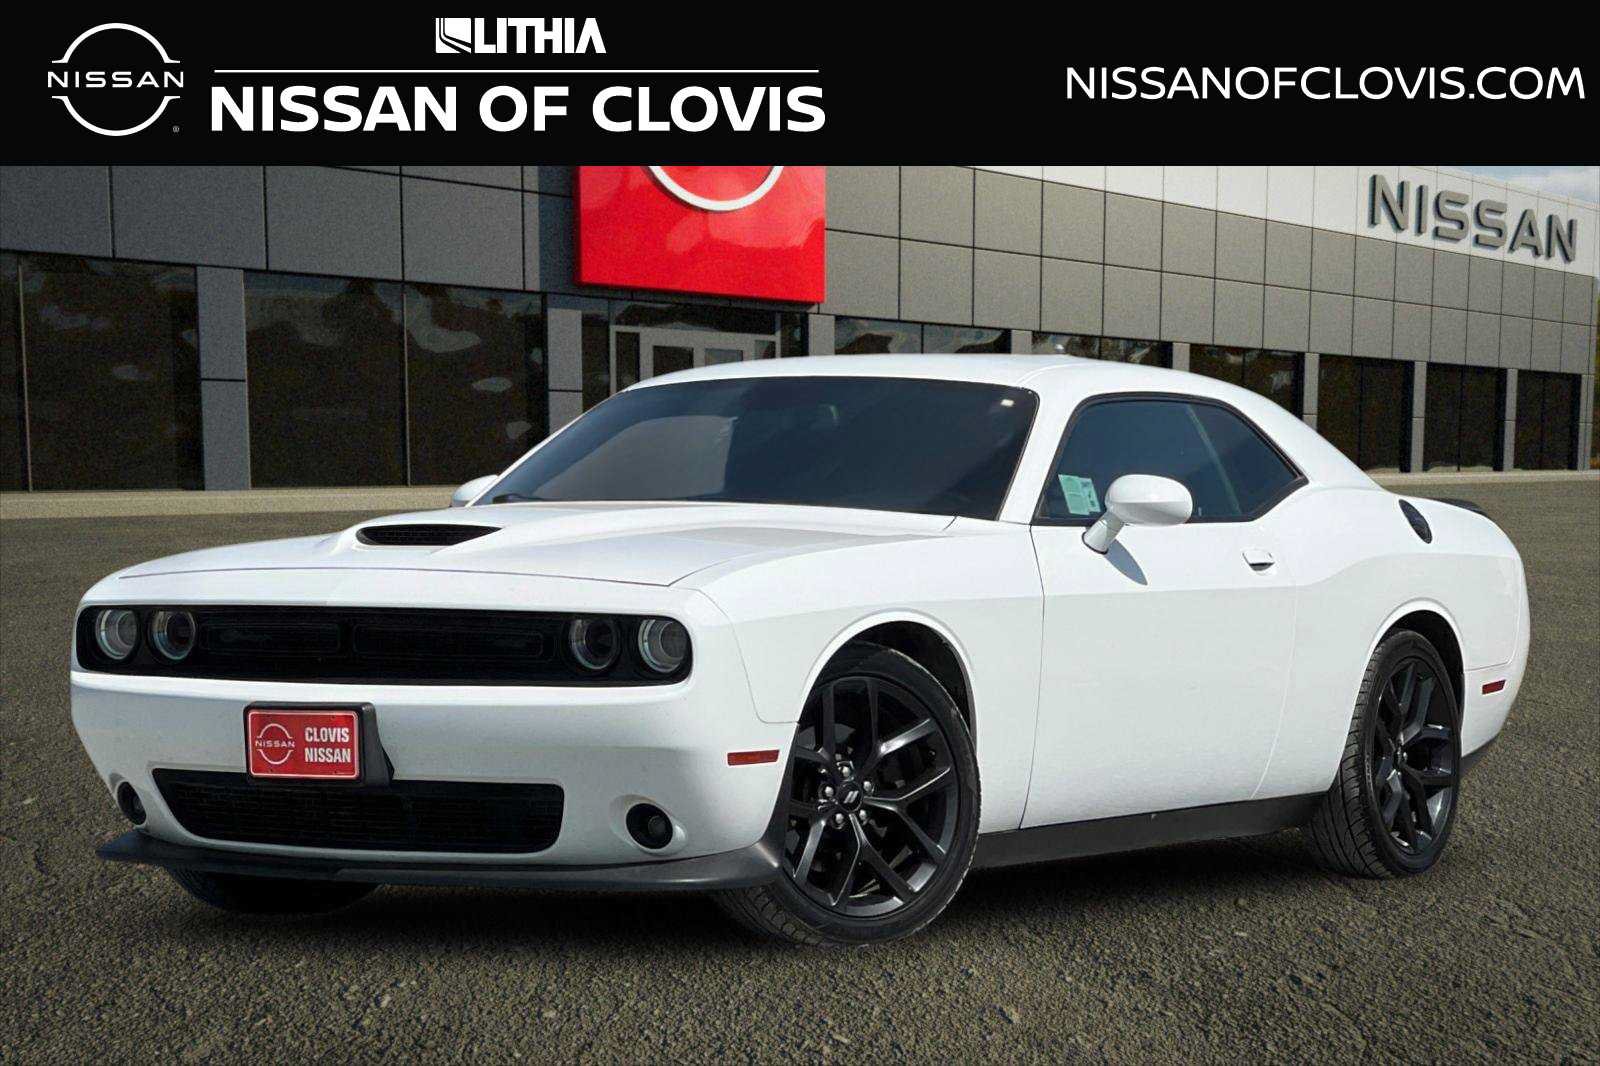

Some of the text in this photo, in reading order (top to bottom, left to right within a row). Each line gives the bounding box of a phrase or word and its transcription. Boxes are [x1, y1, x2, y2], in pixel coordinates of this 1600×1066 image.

[1367, 174, 1577, 264] NISSAN
[305, 727, 349, 742] CLOVIS
[255, 740, 295, 748] NISSAN
[304, 748, 351, 762] NISSAN
